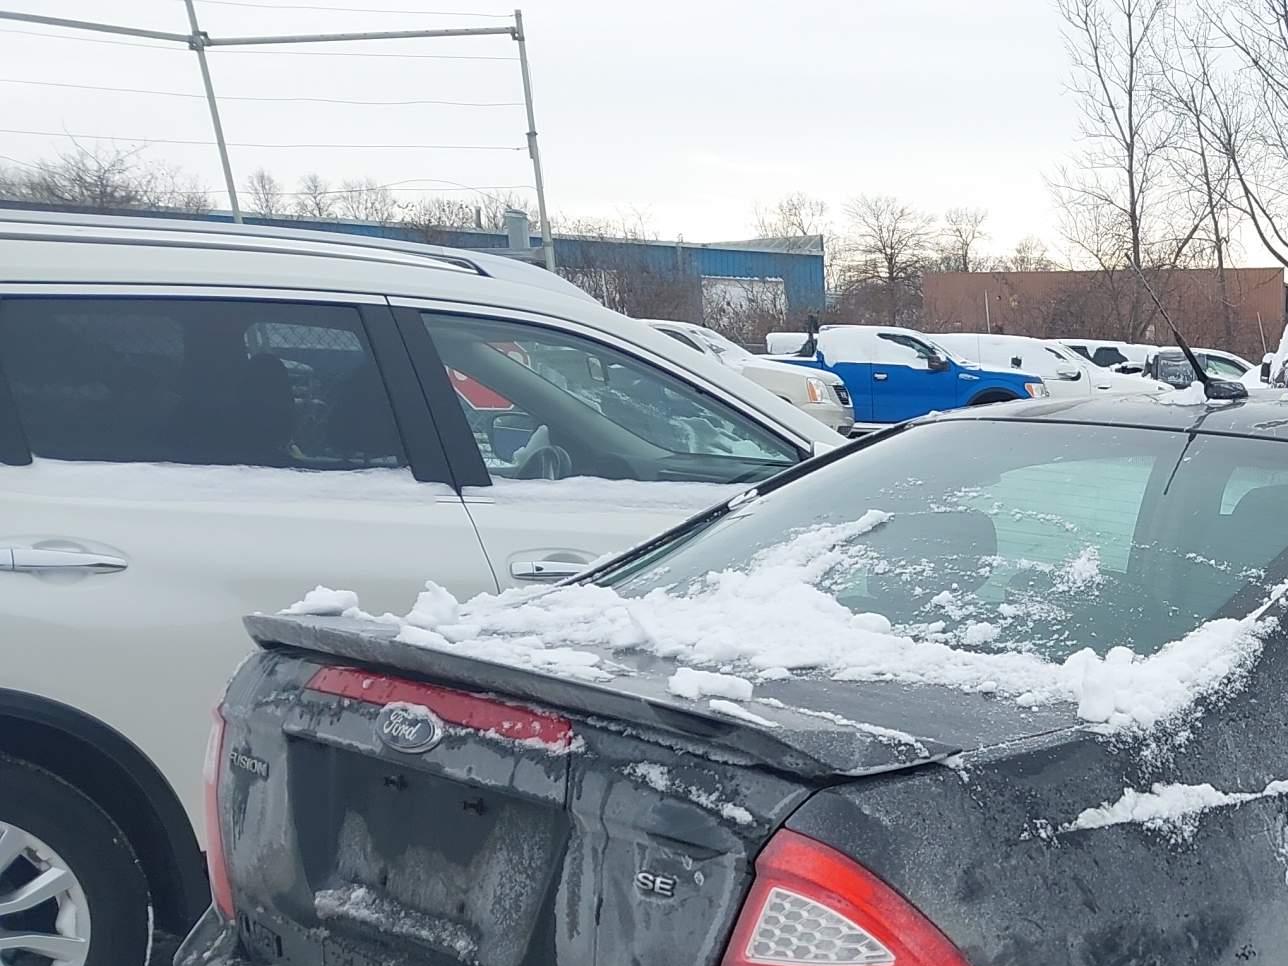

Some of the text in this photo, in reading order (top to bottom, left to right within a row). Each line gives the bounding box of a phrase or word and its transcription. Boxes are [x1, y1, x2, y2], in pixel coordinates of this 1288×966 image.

[383, 709, 422, 741] Ford
[228, 751, 269, 777] FUSION
[636, 871, 674, 897] SE
